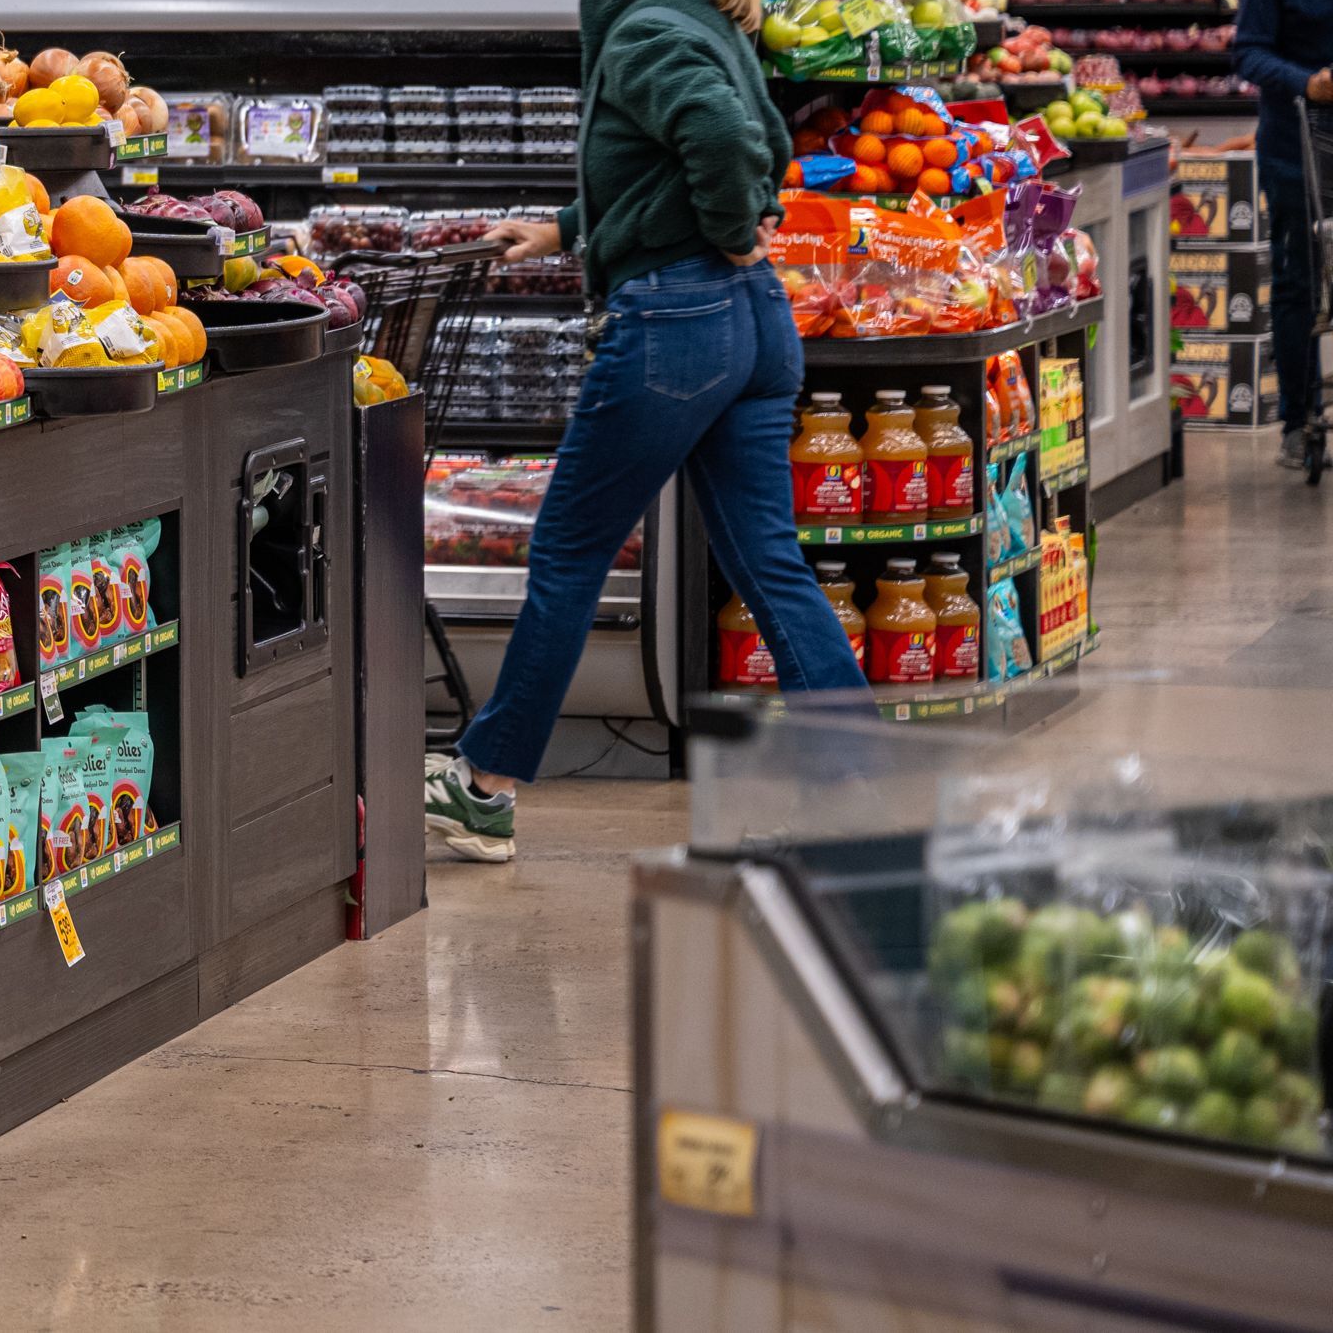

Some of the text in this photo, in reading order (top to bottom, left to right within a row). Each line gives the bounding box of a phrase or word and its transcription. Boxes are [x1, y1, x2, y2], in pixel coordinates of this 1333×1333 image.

[867, 528, 903, 540] ORGANIC
[12, 692, 30, 707] ORGANIC
[15, 898, 33, 914] ORGANIC
